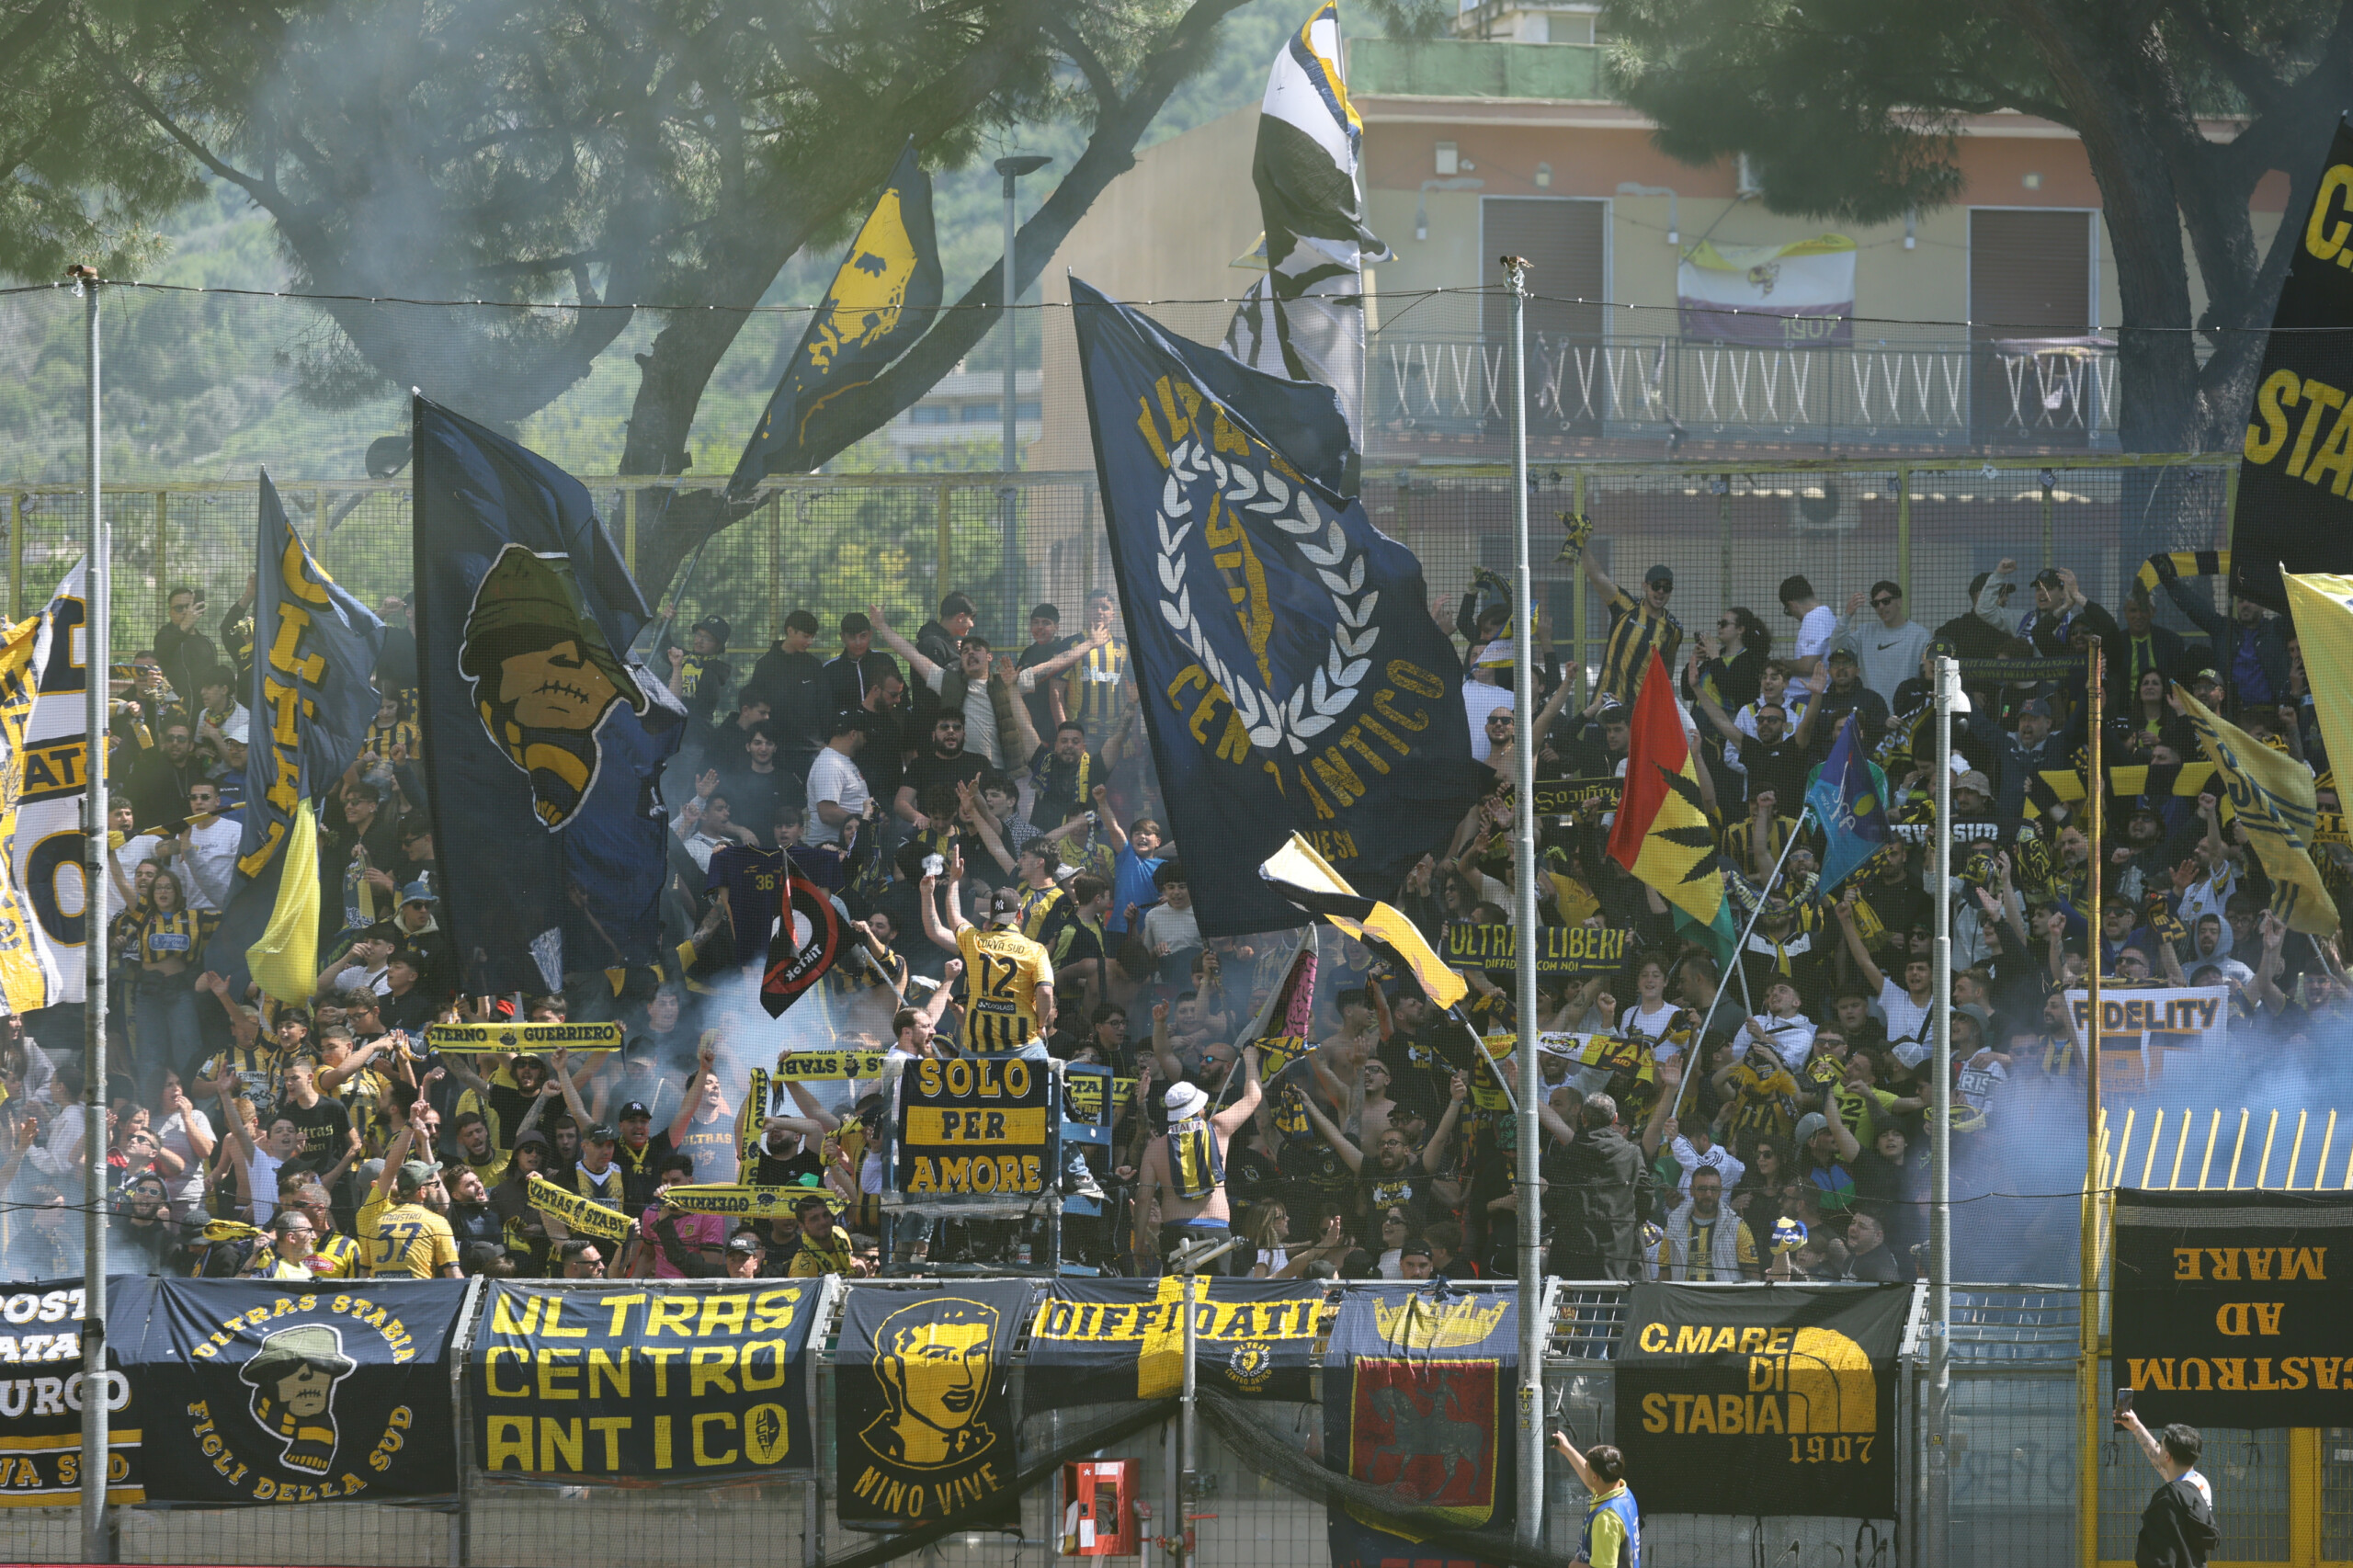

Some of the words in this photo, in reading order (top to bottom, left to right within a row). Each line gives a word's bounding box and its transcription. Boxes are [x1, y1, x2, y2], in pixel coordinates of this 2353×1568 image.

[755, 874, 774, 890] 36
[1007, 943, 1025, 954] SUD
[1449, 924, 1540, 957] ULTRA
[1548, 926, 1625, 960] LIBERI
[979, 952, 1015, 998] 12
[1484, 958, 1517, 970] DIFFID
[2074, 997, 2221, 1030] FDELITY
[524, 1025, 615, 1041] GUERRIERO
[919, 1058, 1032, 1097] SOLO
[296, 1123, 334, 1140] ltras
[940, 1110, 1006, 1142] PER
[907, 1154, 1042, 1194] AMORE
[375, 1221, 423, 1264] 37
[2173, 1246, 2328, 1281] MARE
[191, 1293, 317, 1358] ULTRAS
[330, 1294, 416, 1365] STABIA
[491, 1287, 802, 1338] ULTRAS
[2215, 1301, 2286, 1336] AD
[1639, 1323, 1793, 1355] C.MARE
[485, 1338, 787, 1400] CENTRO
[1748, 1356, 1784, 1392] DI
[1642, 1392, 1784, 1435] STABIA
[187, 1399, 248, 1486] FIGLI
[252, 1472, 369, 1503] DELLA
[369, 1404, 414, 1472] SUD
[486, 1402, 790, 1471] ANTICO
[1788, 1436, 1875, 1465] 1907
[57, 1452, 130, 1485] SD
[852, 1465, 924, 1517] NINO
[935, 1461, 1005, 1516] VIVE
